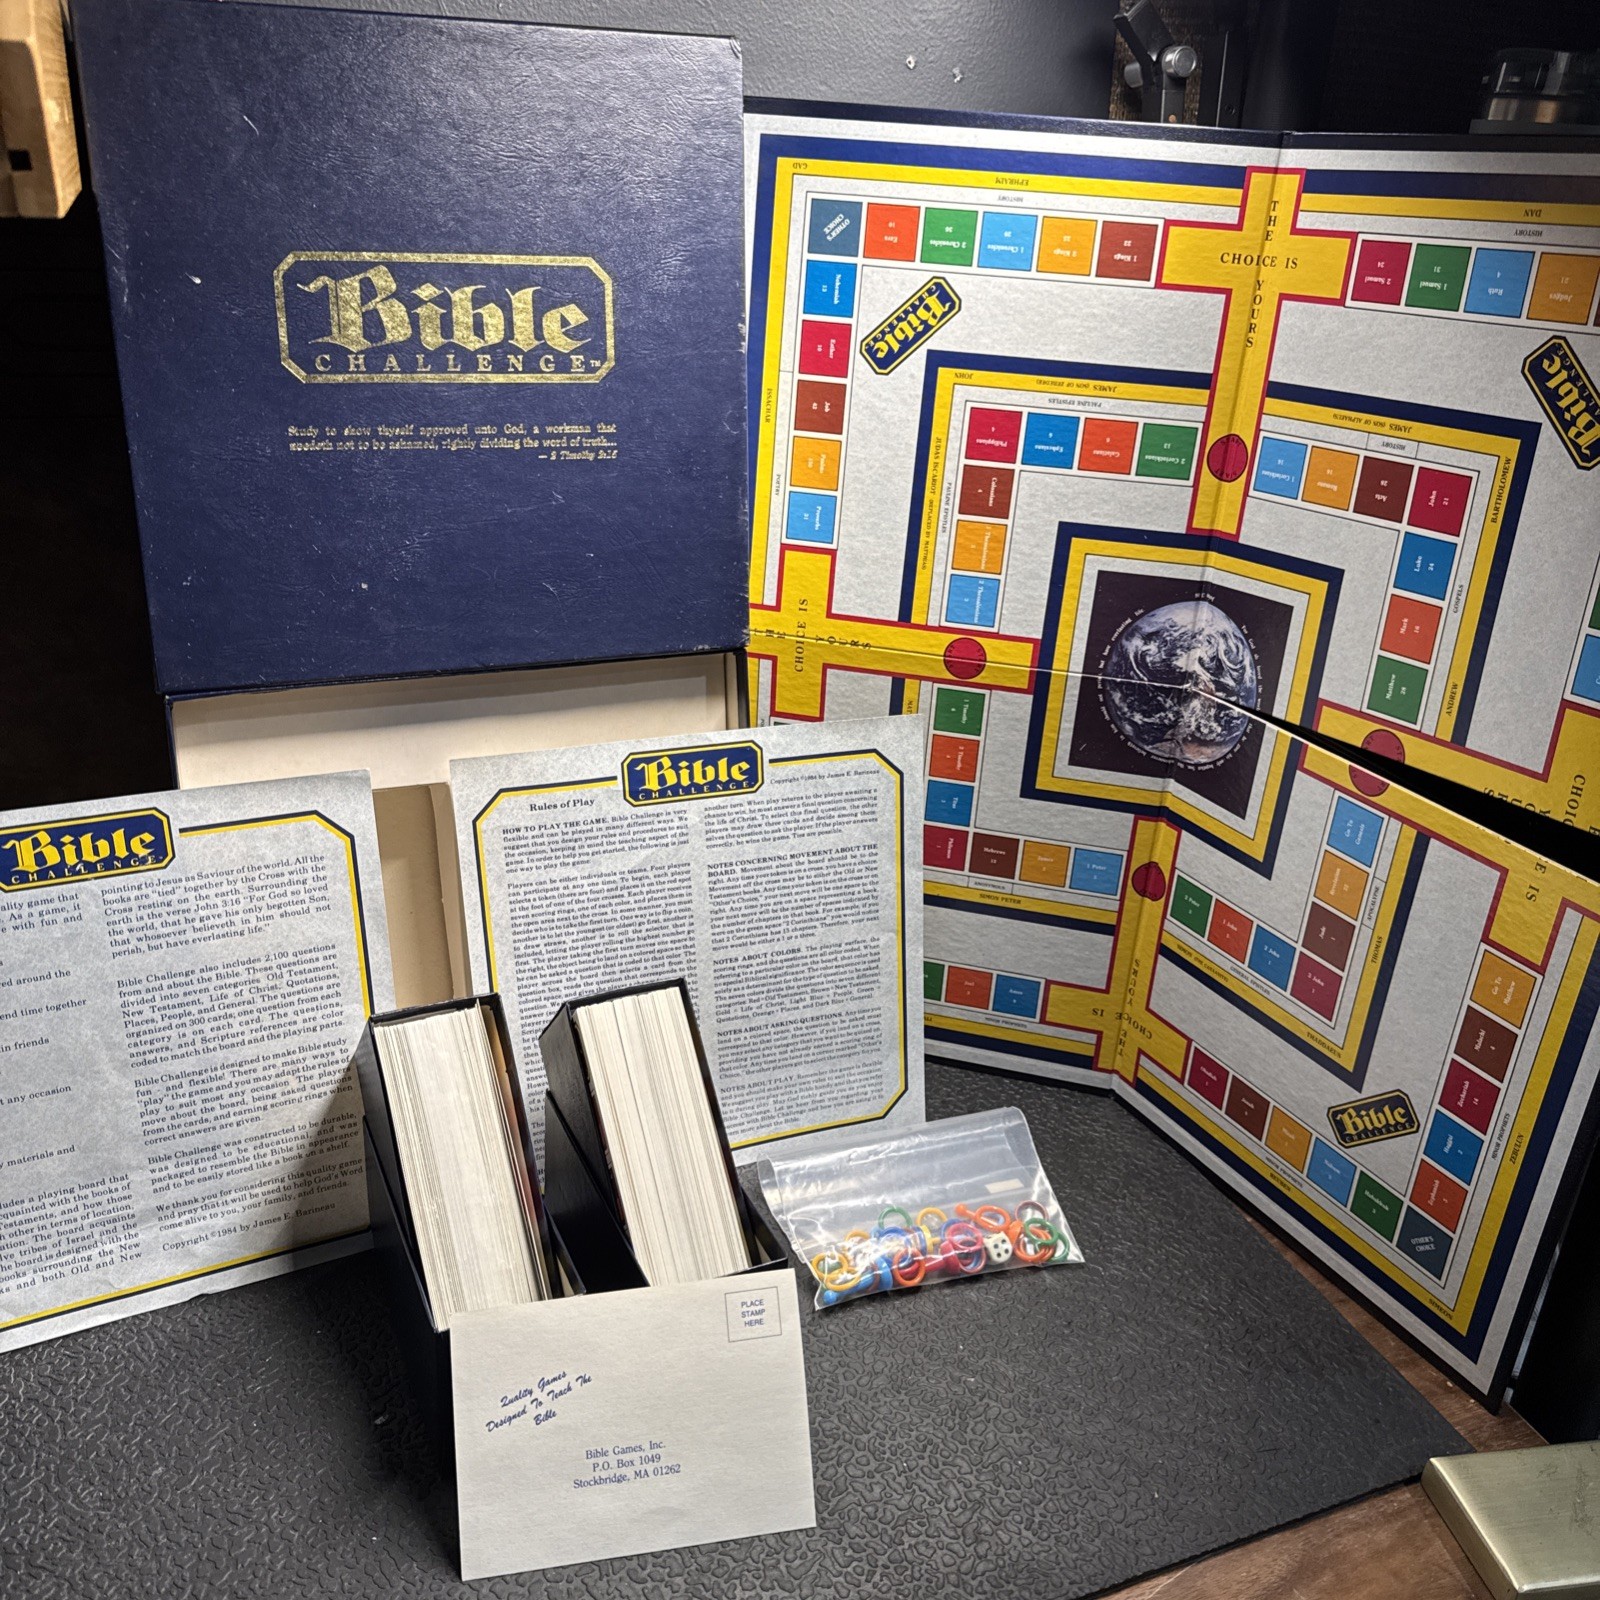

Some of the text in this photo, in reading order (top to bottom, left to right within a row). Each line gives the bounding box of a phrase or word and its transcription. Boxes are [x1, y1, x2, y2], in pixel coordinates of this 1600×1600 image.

[996, 177, 1029, 186] EPHRAIM
[1265, 201, 1278, 241] THE
[1524, 209, 1542, 217] DAN
[823, 214, 844, 234] CHOICE
[1514, 229, 1542, 237] HISTORY
[930, 239, 960, 248] Chronicles
[1220, 252, 1298, 269] CHOICE IS
[1365, 276, 1385, 284] Samuel
[1419, 281, 1441, 290] Samuel
[1488, 287, 1503, 296] Ruth
[1549, 293, 1573, 302] Judges
[297, 265, 591, 352] Bible
[1246, 280, 1264, 348] YOURS
[873, 290, 951, 358] Bible
[1093, 384, 1117, 392] JAMES
[1077, 399, 1102, 407] PAULINE
[1542, 353, 1600, 455] Bible
[288, 425, 318, 437] Study
[326, 426, 337, 435] to
[378, 424, 414, 437] thyself
[420, 424, 468, 437] approved
[474, 424, 497, 435] unto
[504, 424, 527, 435] God,
[546, 424, 590, 434] workman
[597, 423, 616, 433] that
[1389, 423, 1412, 434] JAMES
[337, 439, 354, 450] not
[359, 439, 369, 449] to
[372, 438, 385, 449] be
[442, 437, 476, 450] rightly
[480, 437, 520, 450] dividing
[524, 437, 539, 448] the
[543, 437, 566, 448] word
[570, 436, 581, 447] of
[976, 438, 1008, 447] Philippians
[1034, 444, 1063, 452] Ephesians
[1382, 441, 1406, 450] HISTORY
[560, 450, 595, 462] Timothy
[930, 464, 940, 495] ISCARIOT
[988, 477, 996, 507] Colossians
[1375, 493, 1387, 502] Acts
[1429, 490, 1437, 507] John
[1491, 456, 1511, 524] BARTHOLOMEW
[814, 506, 822, 531] Proverbs
[1414, 555, 1423, 572] Luke
[1453, 584, 1463, 613] GOSPELS
[795, 598, 808, 672] CHOICE IS
[1400, 618, 1409, 635] Mark
[1386, 674, 1396, 700] Matthew
[1446, 682, 1458, 716] ANDREW
[634, 756, 750, 791] Bible
[639, 781, 749, 799] CHALLENGE
[530, 798, 595, 812] Rules of Play
[525, 825, 536, 833] TO
[538, 822, 561, 832] PLAY
[1345, 820, 1353, 837] Go To
[1355, 823, 1365, 846] Genesis
[2, 828, 155, 872] Bible
[707, 862, 733, 870] NOTES
[735, 854, 787, 866] CONCERNING
[789, 848, 832, 860] MOVEMENT
[835, 845, 861, 854] ABOUT
[102, 854, 325, 897] pointing to Jesus as Saviour of the world. All the
[979, 893, 1021, 904] SIMON PETER
[1367, 886, 1380, 921] APOCALYPSE
[1371, 936, 1383, 964] THOMAS
[117, 944, 336, 989] Bible Challenge also includes 2,100 questions
[1503, 980, 1516, 1006] Matthew
[1092, 1008, 1104, 1017] IS
[1306, 1031, 1342, 1059] THADDAEUS
[1336, 1105, 1410, 1134] Bible
[1510, 1133, 1524, 1165] ZEBULUN
[156, 1158, 363, 1213] We thank you for considering this quality game
[163, 1234, 209, 1252] Copyright
[239, 1224, 250, 1234] by
[253, 1216, 282, 1228] James
[284, 1211, 293, 1220] E.
[296, 1203, 336, 1217] Barineau
[1415, 1242, 1435, 1252] CHOICE
[741, 1299, 764, 1308] PLACE
[1428, 1299, 1454, 1321] SIMEON
[741, 1309, 766, 1318] STAMP
[744, 1318, 764, 1327] HERE
[500, 1371, 567, 1408] Quality Games
[486, 1374, 593, 1433] Designed To Teach The
[534, 1409, 557, 1426] Bible
[585, 1440, 666, 1460] Bible Games, Inc.
[593, 1453, 661, 1472] P.O. Box 1049
[573, 1464, 681, 1490] Stockbridge, MA 01262
